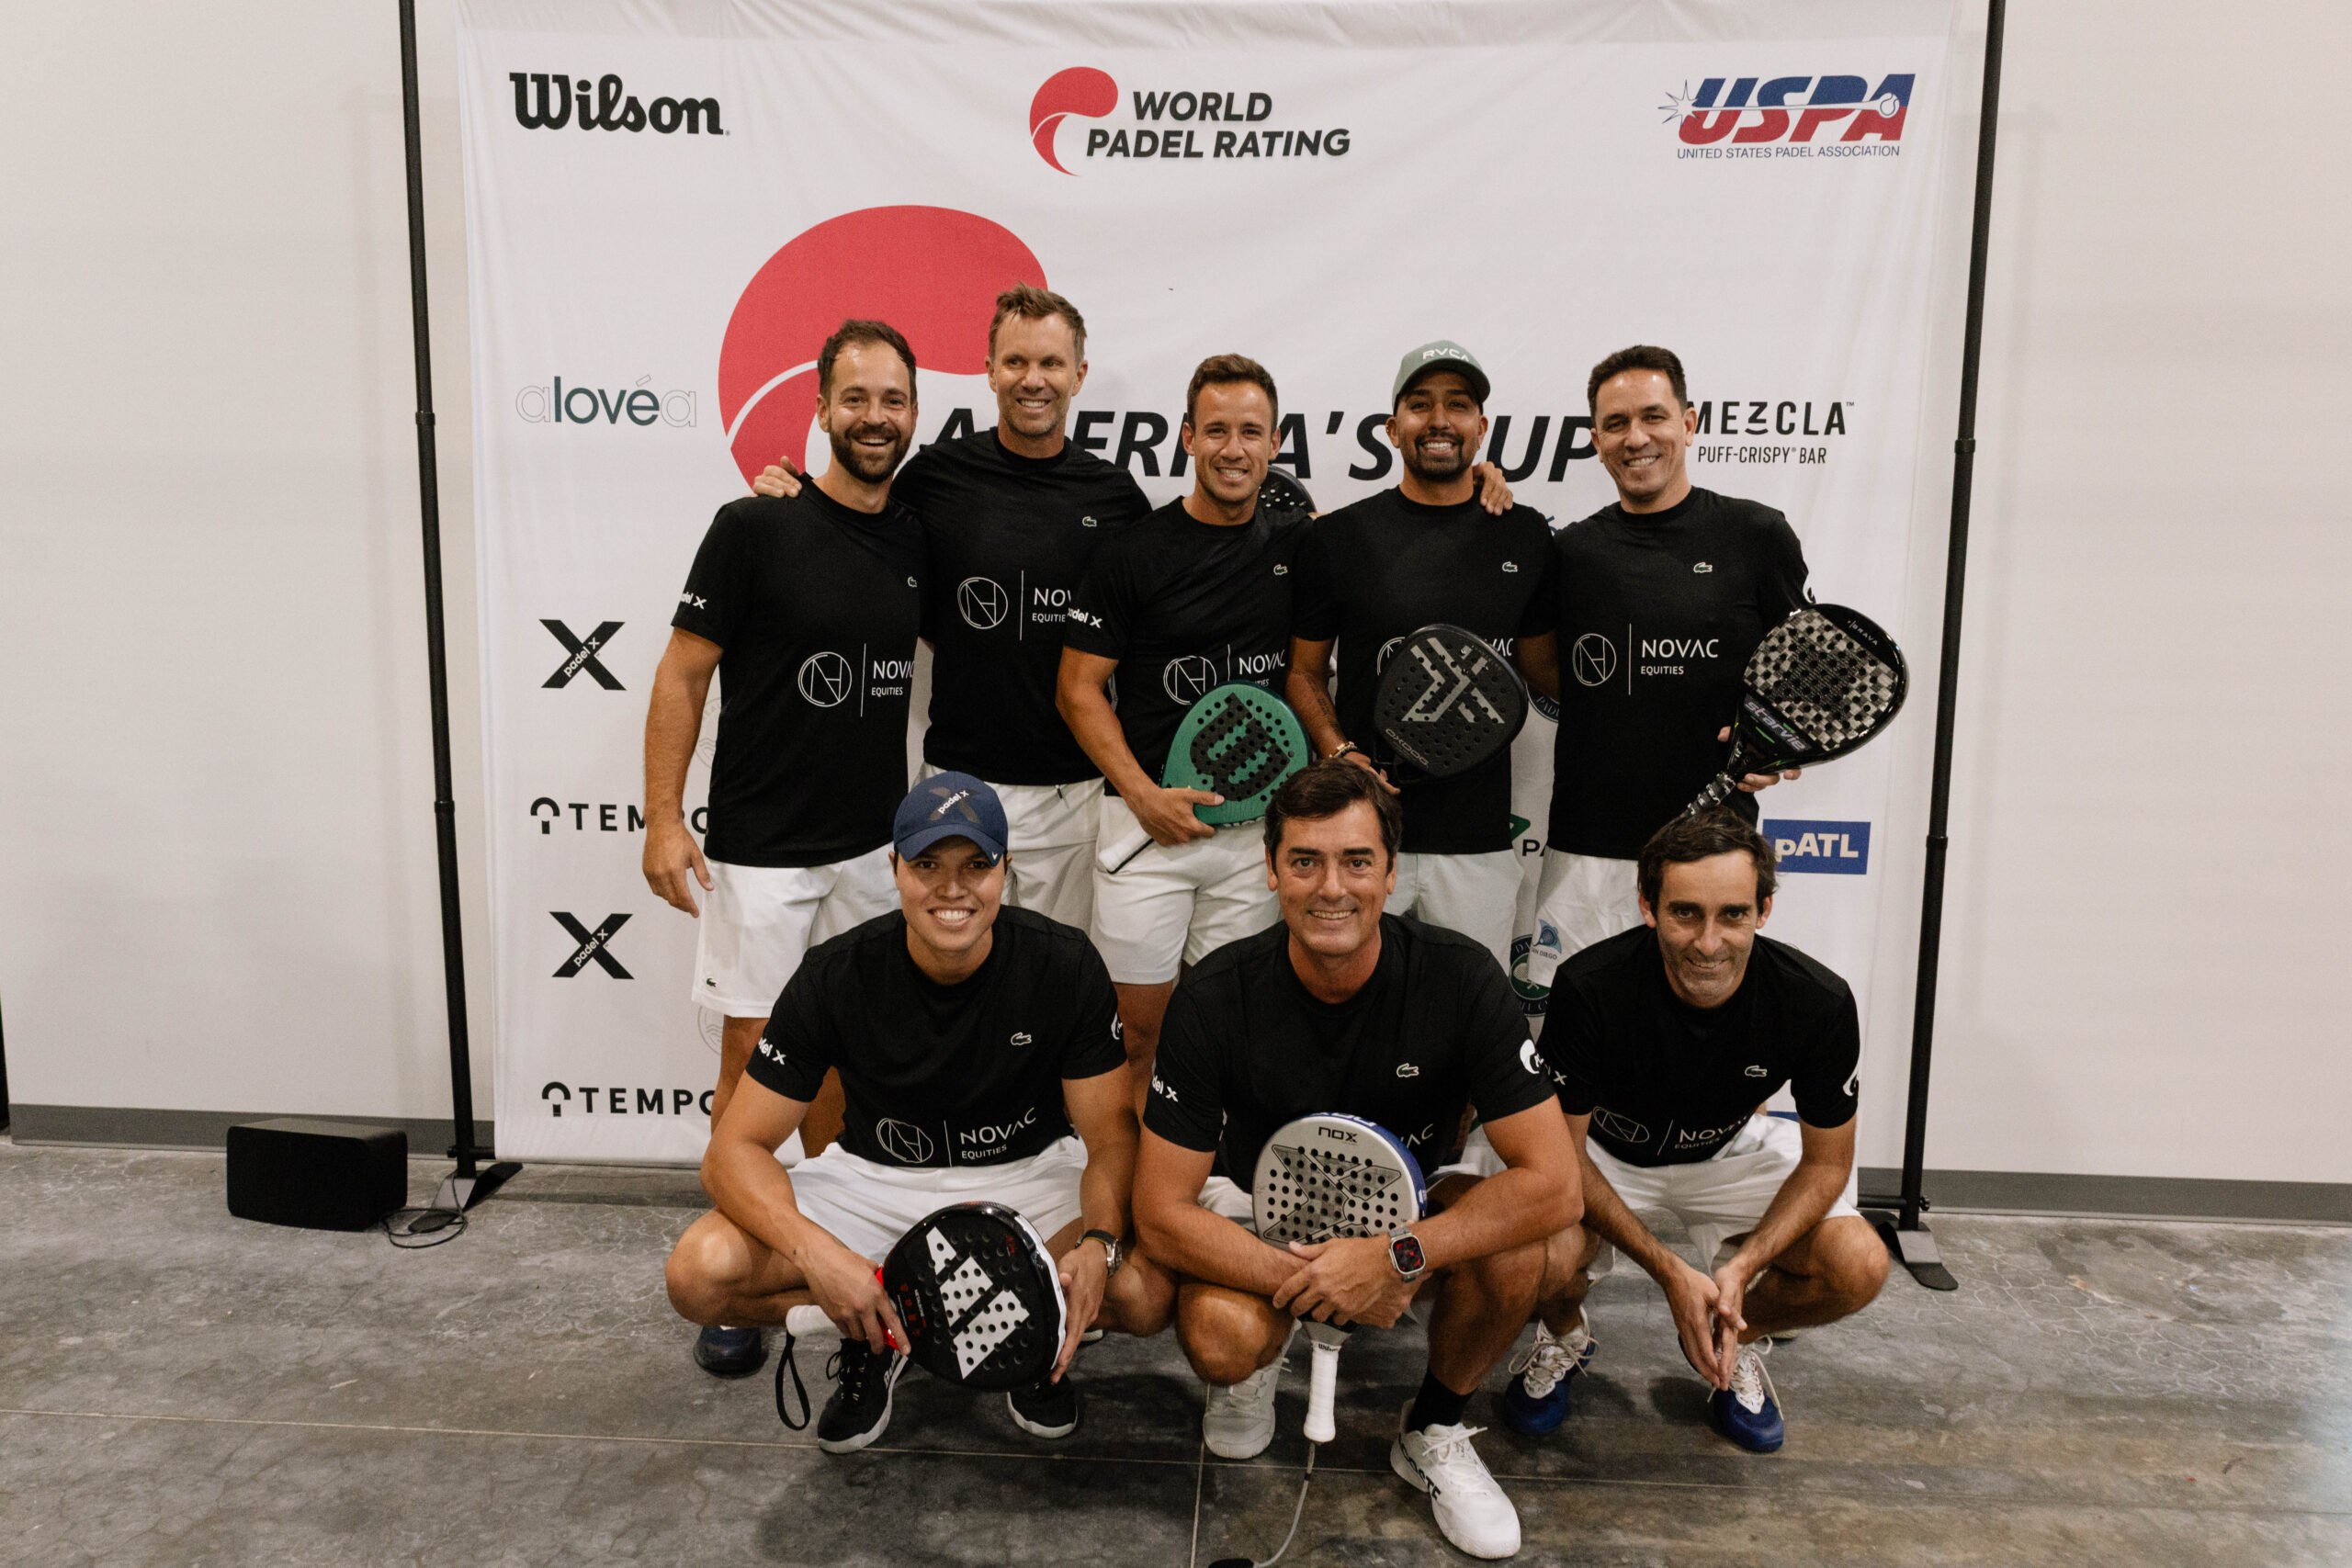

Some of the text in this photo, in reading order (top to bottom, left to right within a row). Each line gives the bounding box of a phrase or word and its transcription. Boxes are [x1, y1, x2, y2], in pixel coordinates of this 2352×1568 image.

[508, 72, 724, 135] Wilson
[1132, 91, 1272, 121] WORLD
[1679, 73, 1916, 144] USPA
[1086, 128, 1351, 158] PADEL RATING
[1677, 145, 1900, 159] UNITED STATES PADEL ASSOCIATION
[1422, 348, 1470, 362] RVCA
[515, 374, 696, 427] alovéa
[1799, 447, 1826, 464] BAR
[1032, 613, 1067, 623] EQUITIE
[1642, 638, 1720, 659] NOVAC
[562, 646, 591, 678] padel
[1641, 666, 1684, 676] EQUITIES
[871, 686, 904, 697] EQUITIES
[938, 793, 962, 814] padel
[573, 937, 599, 967] padel
[960, 1107, 1036, 1145] NOVAC
[961, 1145, 1007, 1160] EQUITIES
